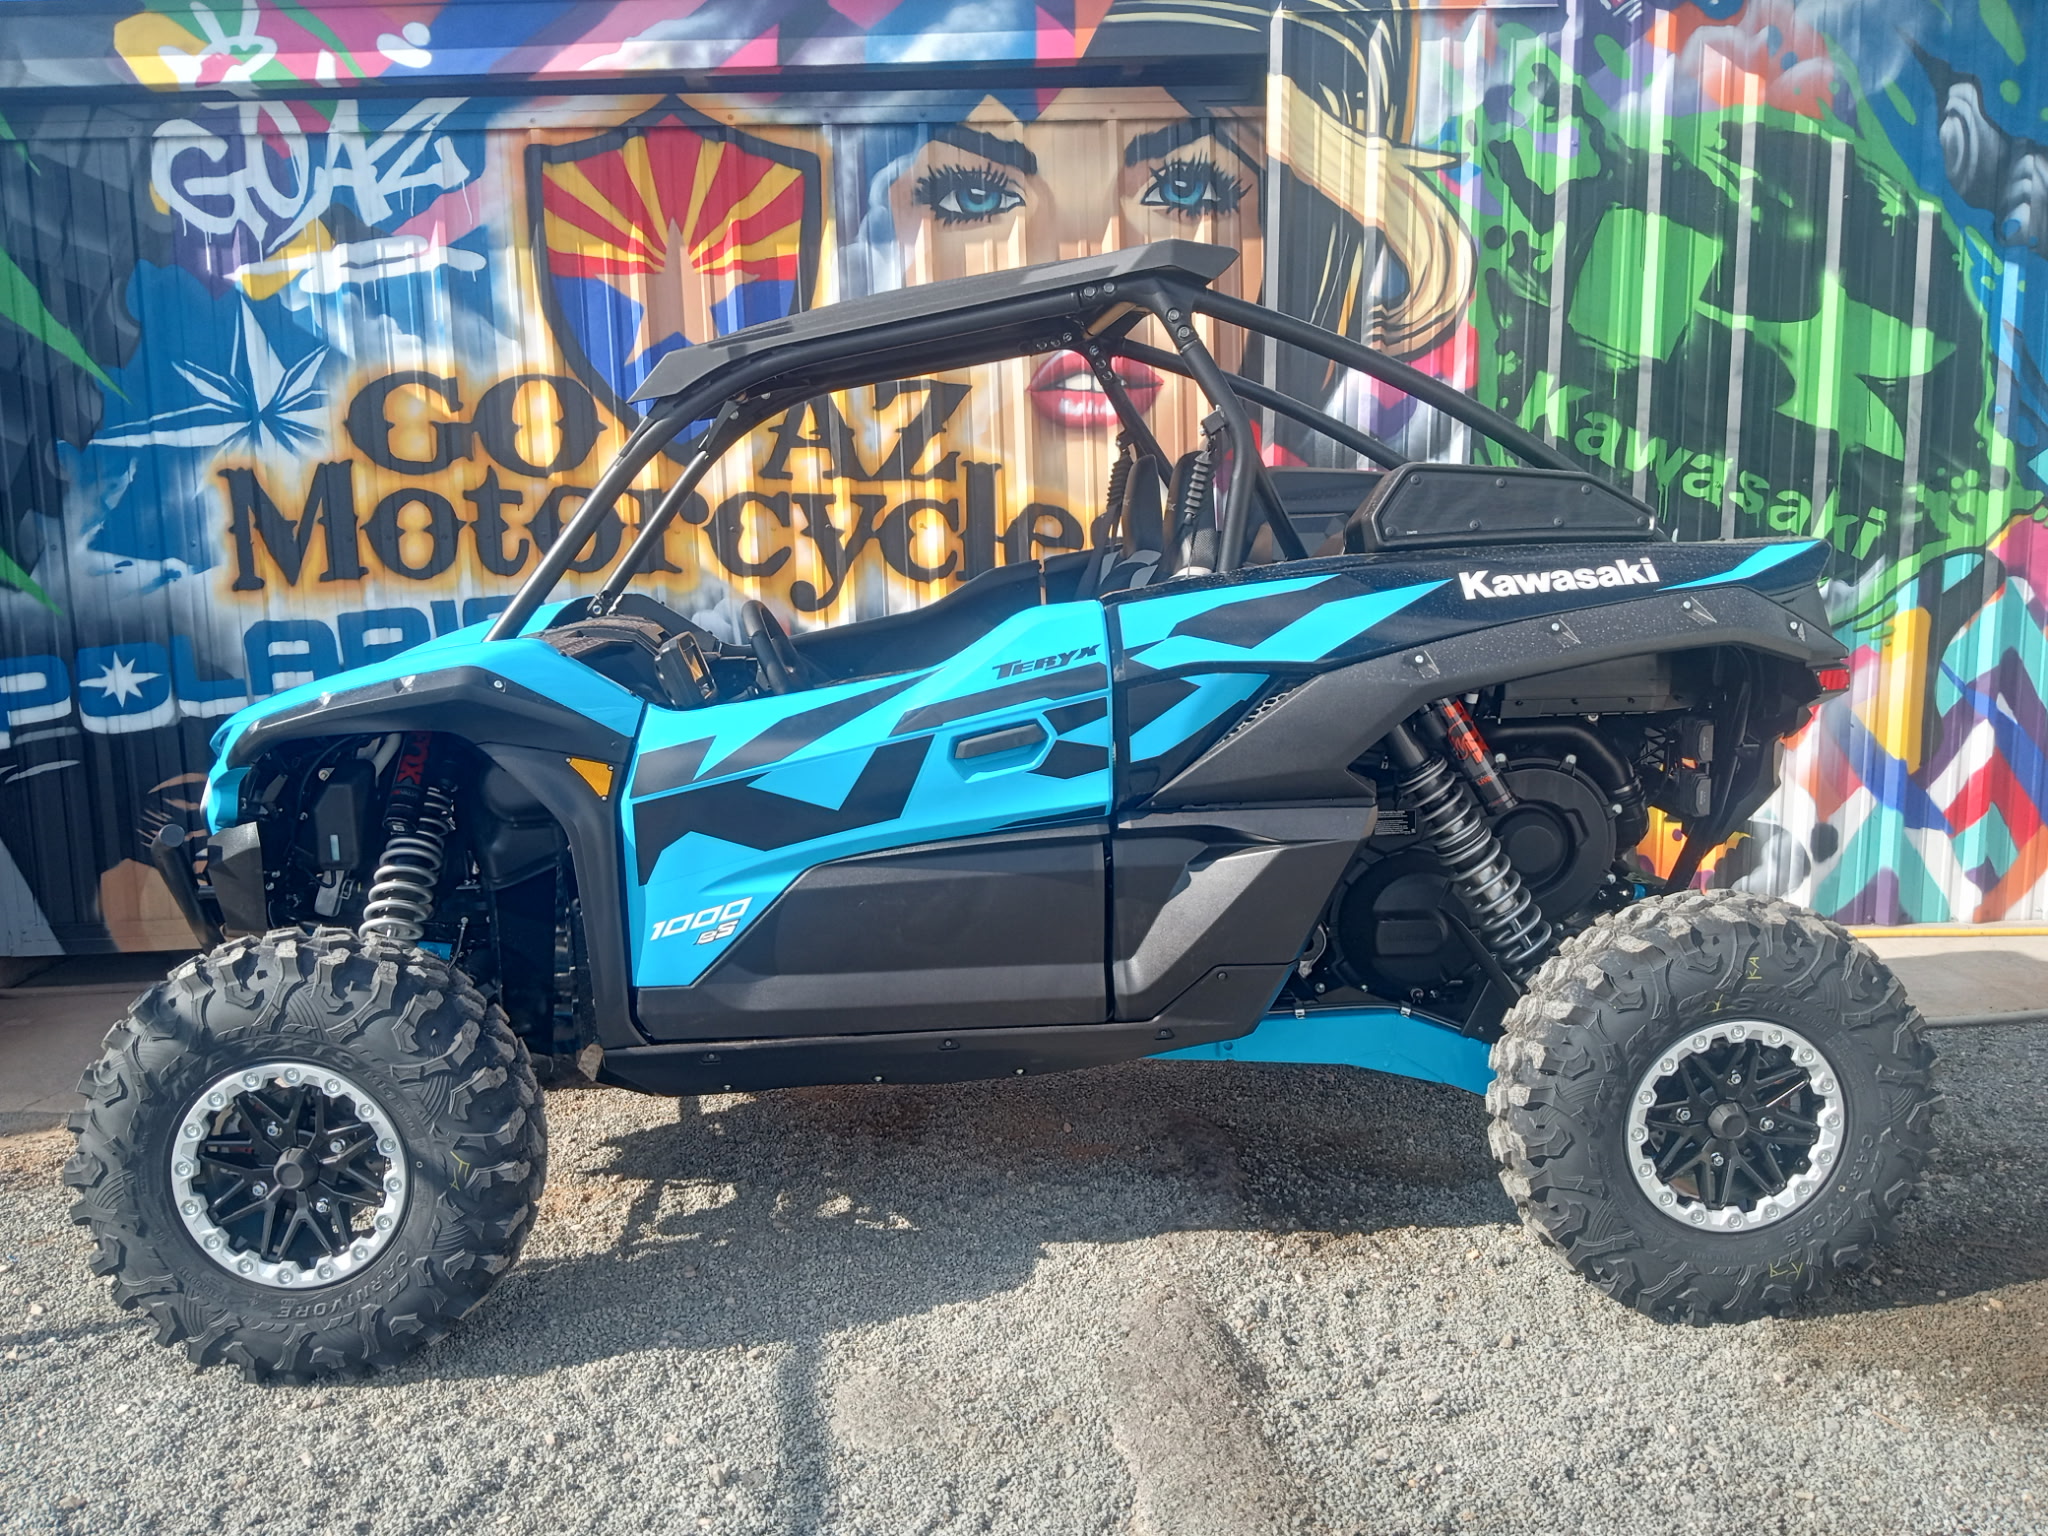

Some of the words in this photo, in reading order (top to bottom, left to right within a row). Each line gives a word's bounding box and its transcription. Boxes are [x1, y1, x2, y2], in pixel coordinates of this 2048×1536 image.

[344, 370, 607, 478] GO
[759, 379, 972, 482] AZ
[1516, 370, 1887, 561] Kawasaki
[1458, 557, 1660, 600] Kawasaki
[0, 597, 522, 738] POLAR
[991, 643, 1101, 680] TERYX
[650, 896, 753, 941] 1000
[276, 1250, 410, 1319] CARNIVORE
